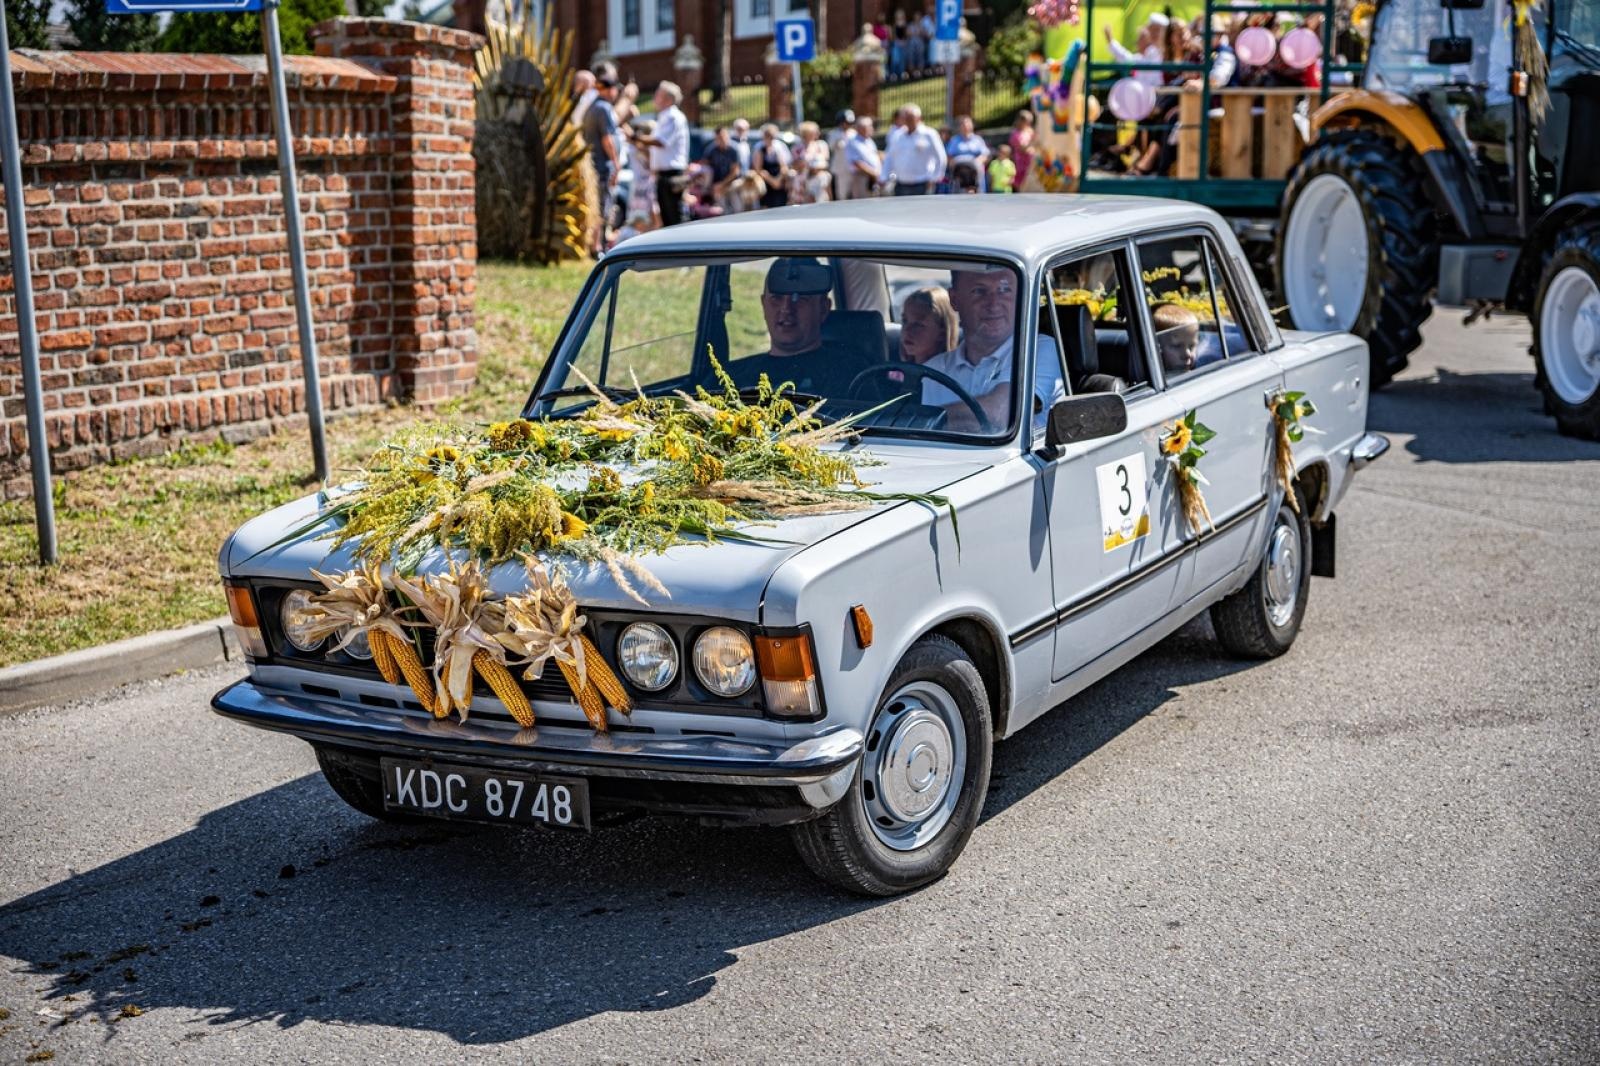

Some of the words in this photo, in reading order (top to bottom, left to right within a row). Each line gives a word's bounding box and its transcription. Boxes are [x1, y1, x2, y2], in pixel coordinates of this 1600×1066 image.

[941, 0, 957, 27] P
[784, 24, 807, 56] P
[1116, 464, 1132, 516] 3
[395, 766, 468, 812] KDC
